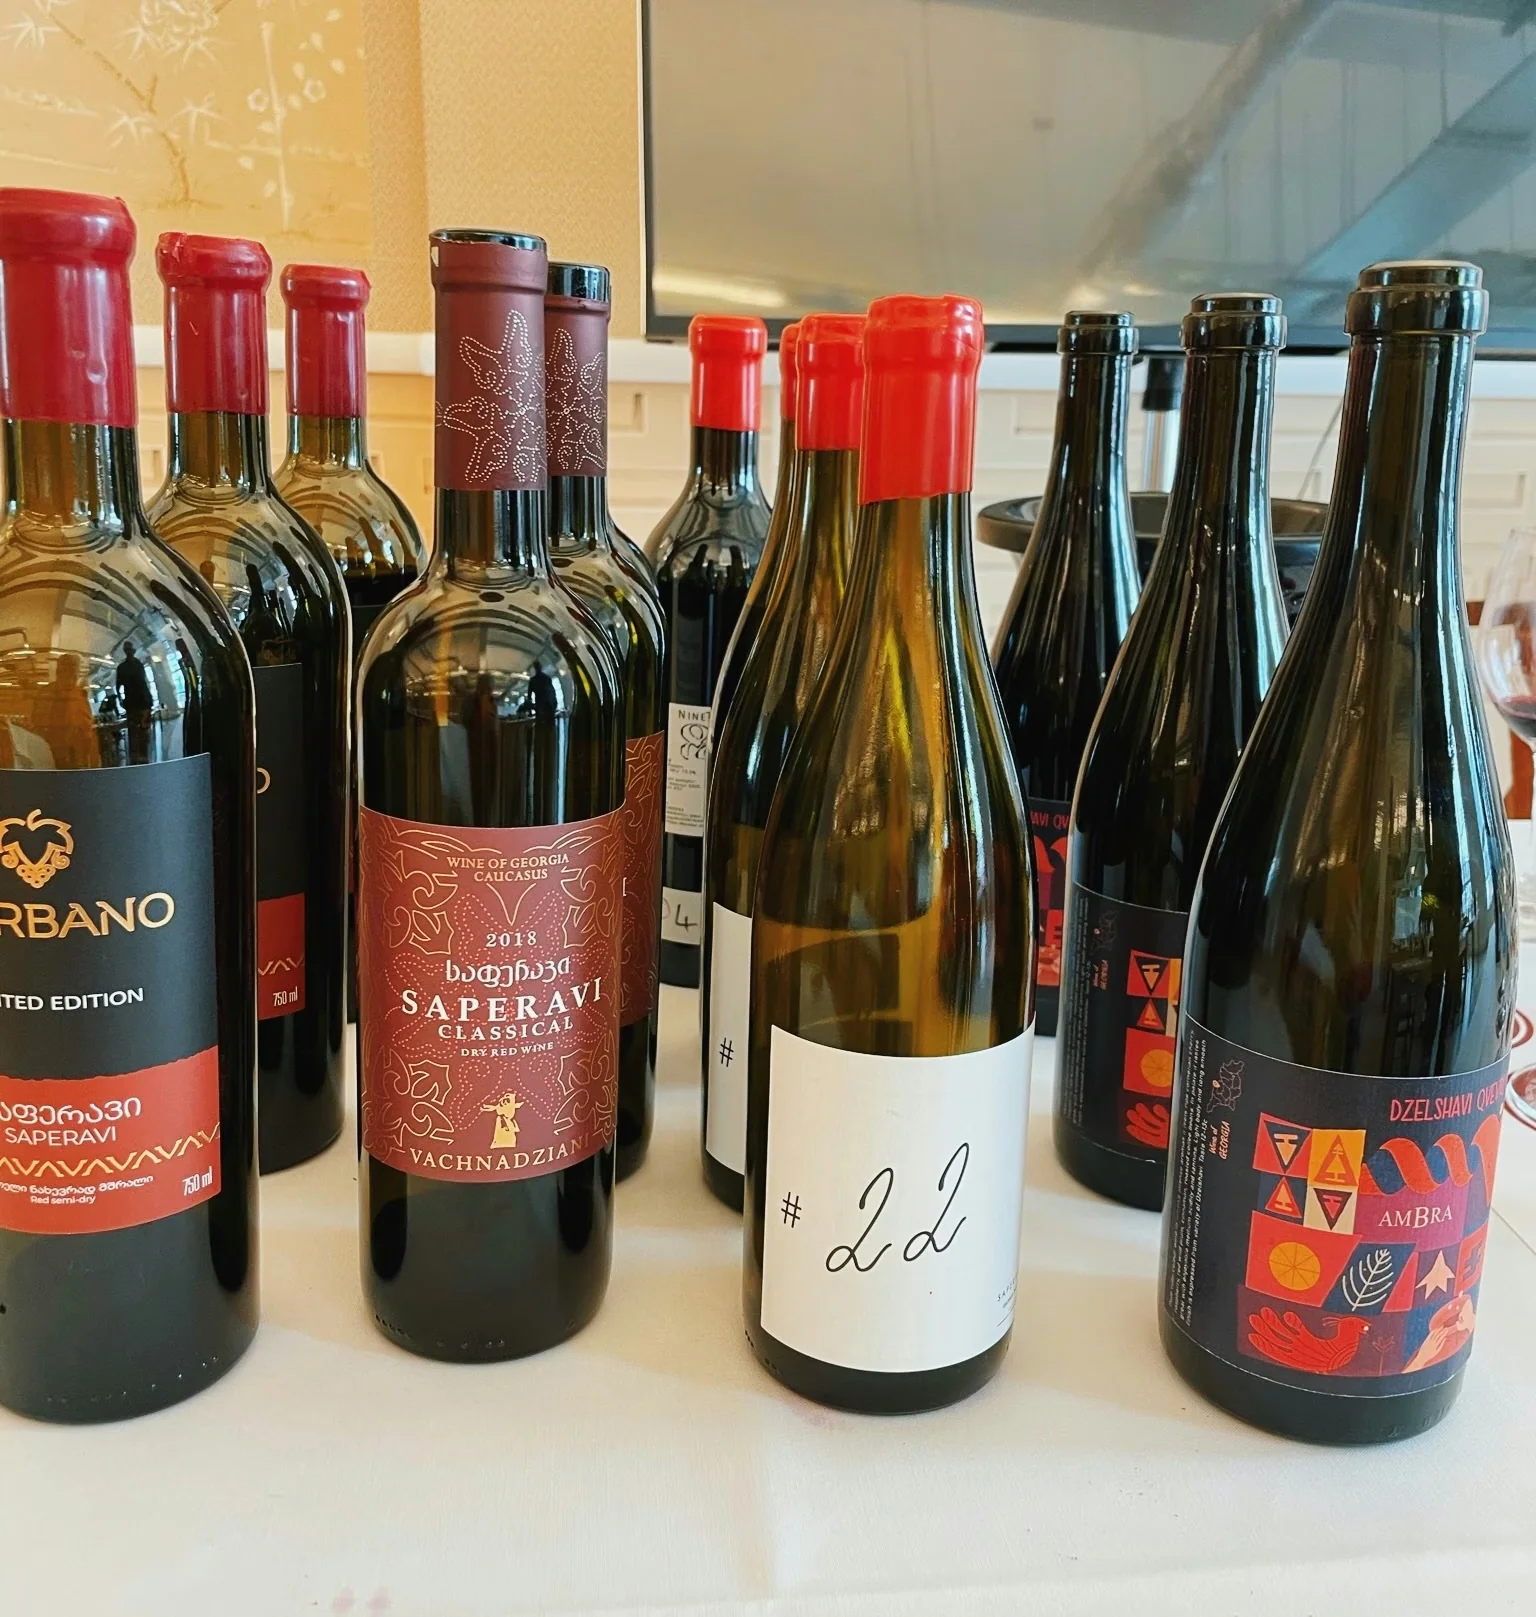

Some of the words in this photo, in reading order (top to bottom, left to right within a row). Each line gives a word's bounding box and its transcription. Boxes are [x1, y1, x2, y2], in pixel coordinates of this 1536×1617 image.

[447, 856, 485, 869] WINE
[488, 858, 508, 869] OF
[510, 853, 570, 868] GEORGIA
[474, 869, 548, 882] CAUCASUS
[486, 931, 538, 947] 2018
[51, 987, 144, 1011] EDITION
[273, 991, 287, 1006] 750
[289, 986, 298, 1002] ml
[402, 977, 602, 1022] SAPERAVI
[438, 1016, 573, 1041] CLASSICAL
[460, 1048, 487, 1057] DRY
[491, 1047, 517, 1056] RED
[521, 1042, 554, 1055] WINE
[1389, 1092, 1473, 1122] DZELSHAVI
[1477, 1074, 1508, 1111] QVE
[5, 1126, 117, 1146] SAPERAVI
[1219, 1120, 1230, 1159] GEORGIA
[409, 1132, 590, 1171] VACHNADZIANI
[182, 1174, 200, 1196] 750
[201, 1165, 213, 1188] ml
[30, 1195, 49, 1204] Red
[51, 1195, 96, 1205] semi-dry
[781, 1192, 802, 1228] #
[825, 1143, 969, 1272] 22
